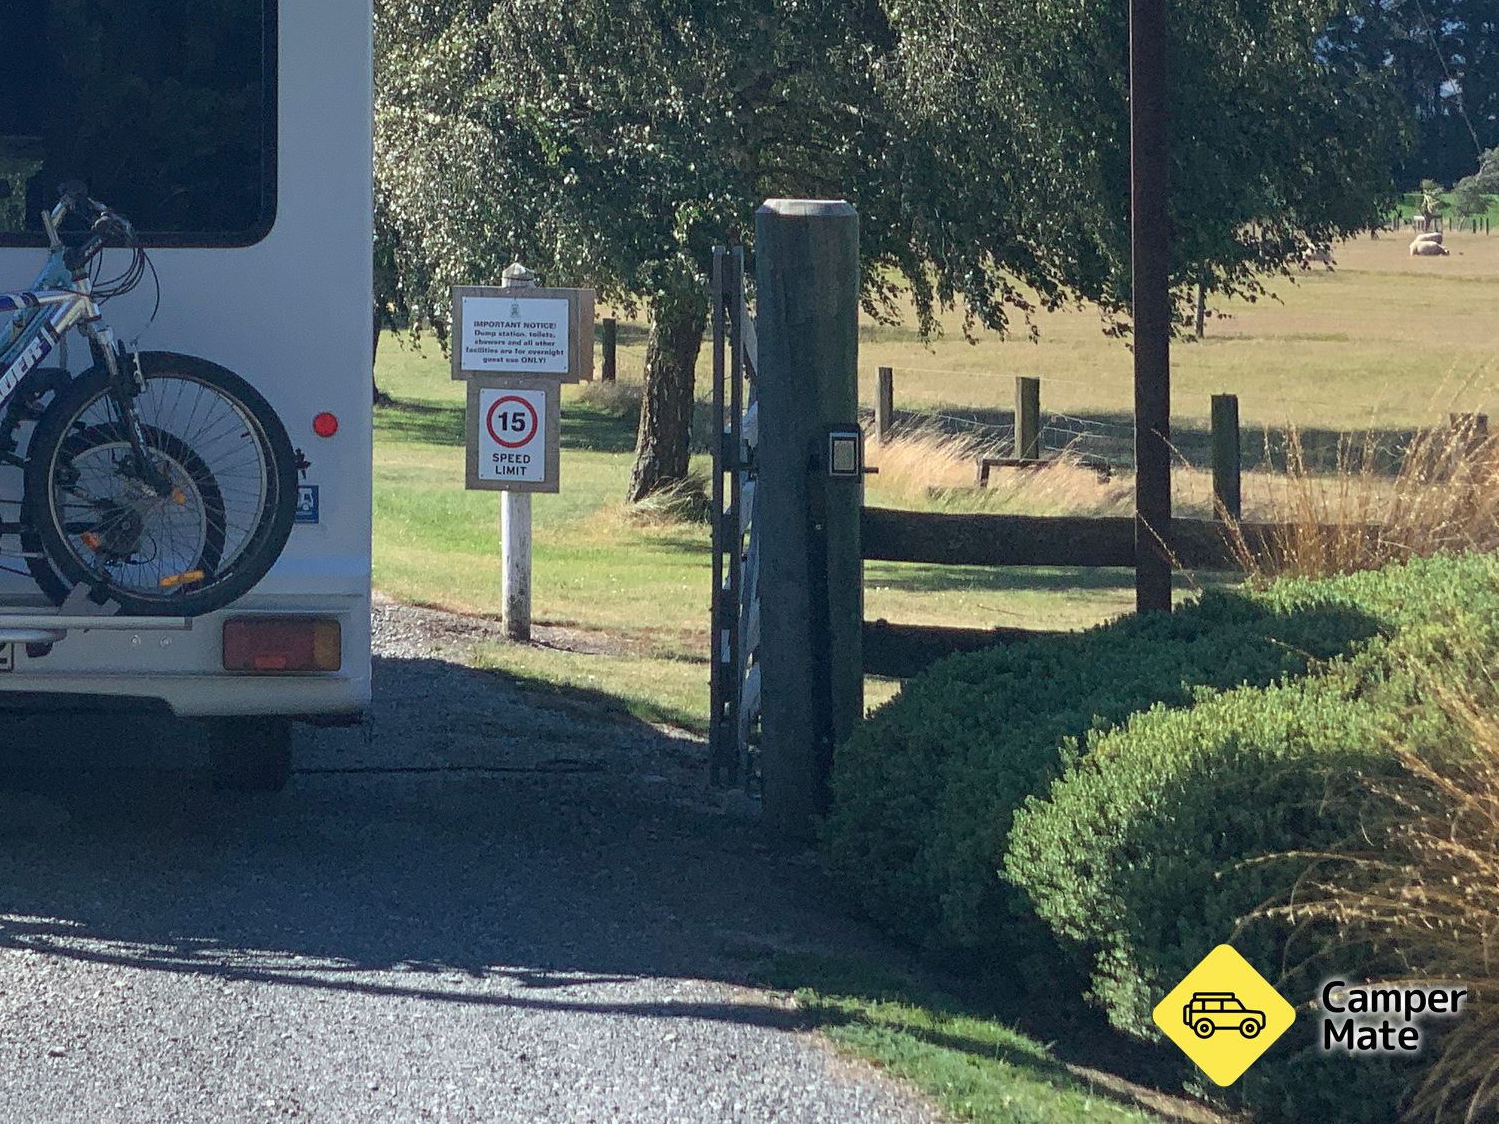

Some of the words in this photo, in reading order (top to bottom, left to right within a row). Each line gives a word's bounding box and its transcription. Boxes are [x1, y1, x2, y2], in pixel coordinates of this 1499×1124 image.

[473, 321, 521, 329] IMPORTANT
[523, 322, 557, 330] NOTICE!
[474, 329, 497, 337] Dump
[521, 356, 546, 364] ONLY!
[498, 411, 526, 432] 15
[492, 452, 531, 464] SPEED
[495, 465, 527, 476] LIMIT
